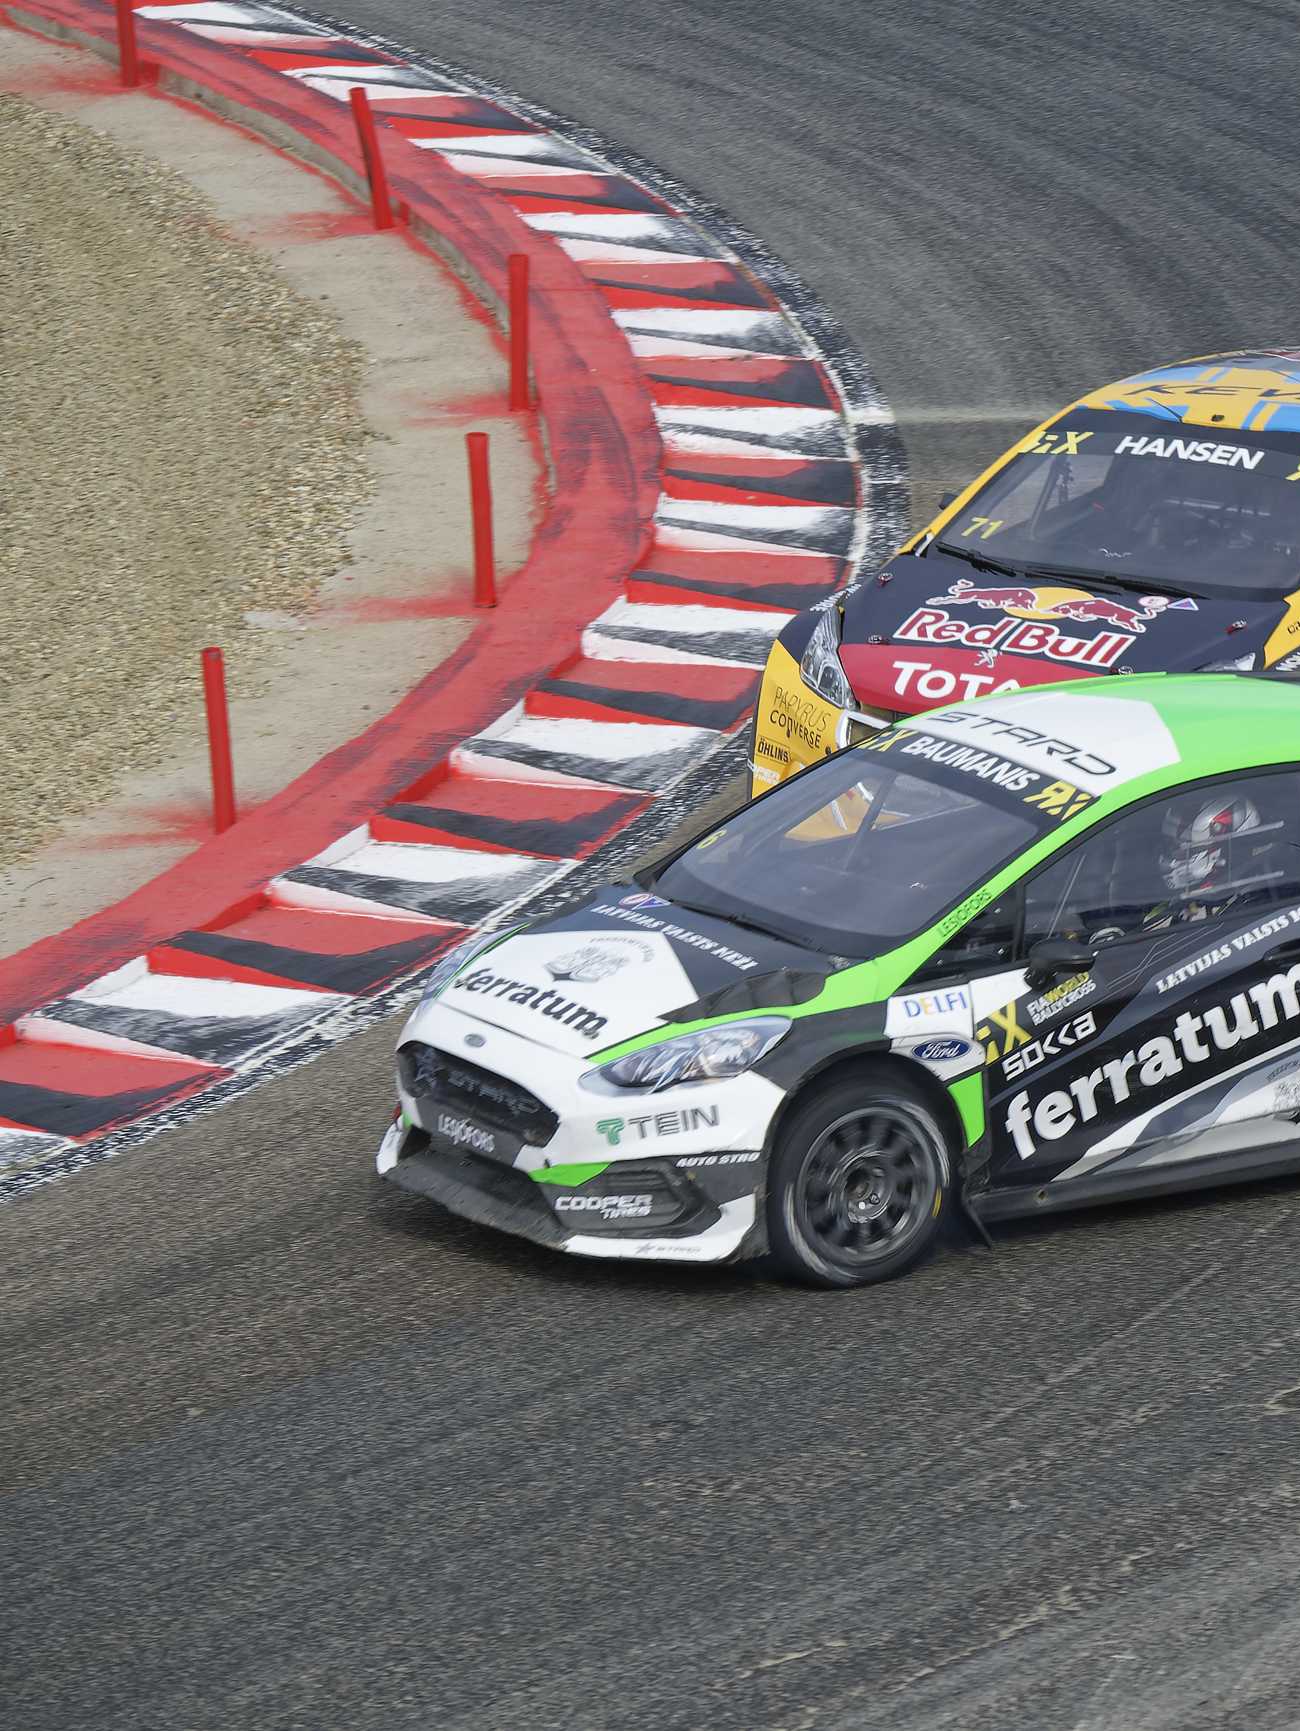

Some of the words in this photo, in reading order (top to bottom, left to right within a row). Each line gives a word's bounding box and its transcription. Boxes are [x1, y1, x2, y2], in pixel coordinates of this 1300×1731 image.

[1115, 435, 1265, 470] HANSEN
[961, 516, 1004, 540] 71
[893, 608, 1008, 649] Red
[1001, 620, 1137, 667] Bull
[773, 686, 832, 733] PAPYRUS
[925, 711, 1118, 777] STARD
[901, 735, 1041, 792] BAUMANIS
[660, 924, 720, 951] VALSTS
[1155, 943, 1233, 995] LATVIJAS
[1230, 914, 1290, 951] VALSTS
[903, 991, 968, 1018] DELFI
[921, 1039, 962, 1061] Ford
[629, 1104, 720, 1141] TEIN
[555, 1194, 654, 1211] COOPER
